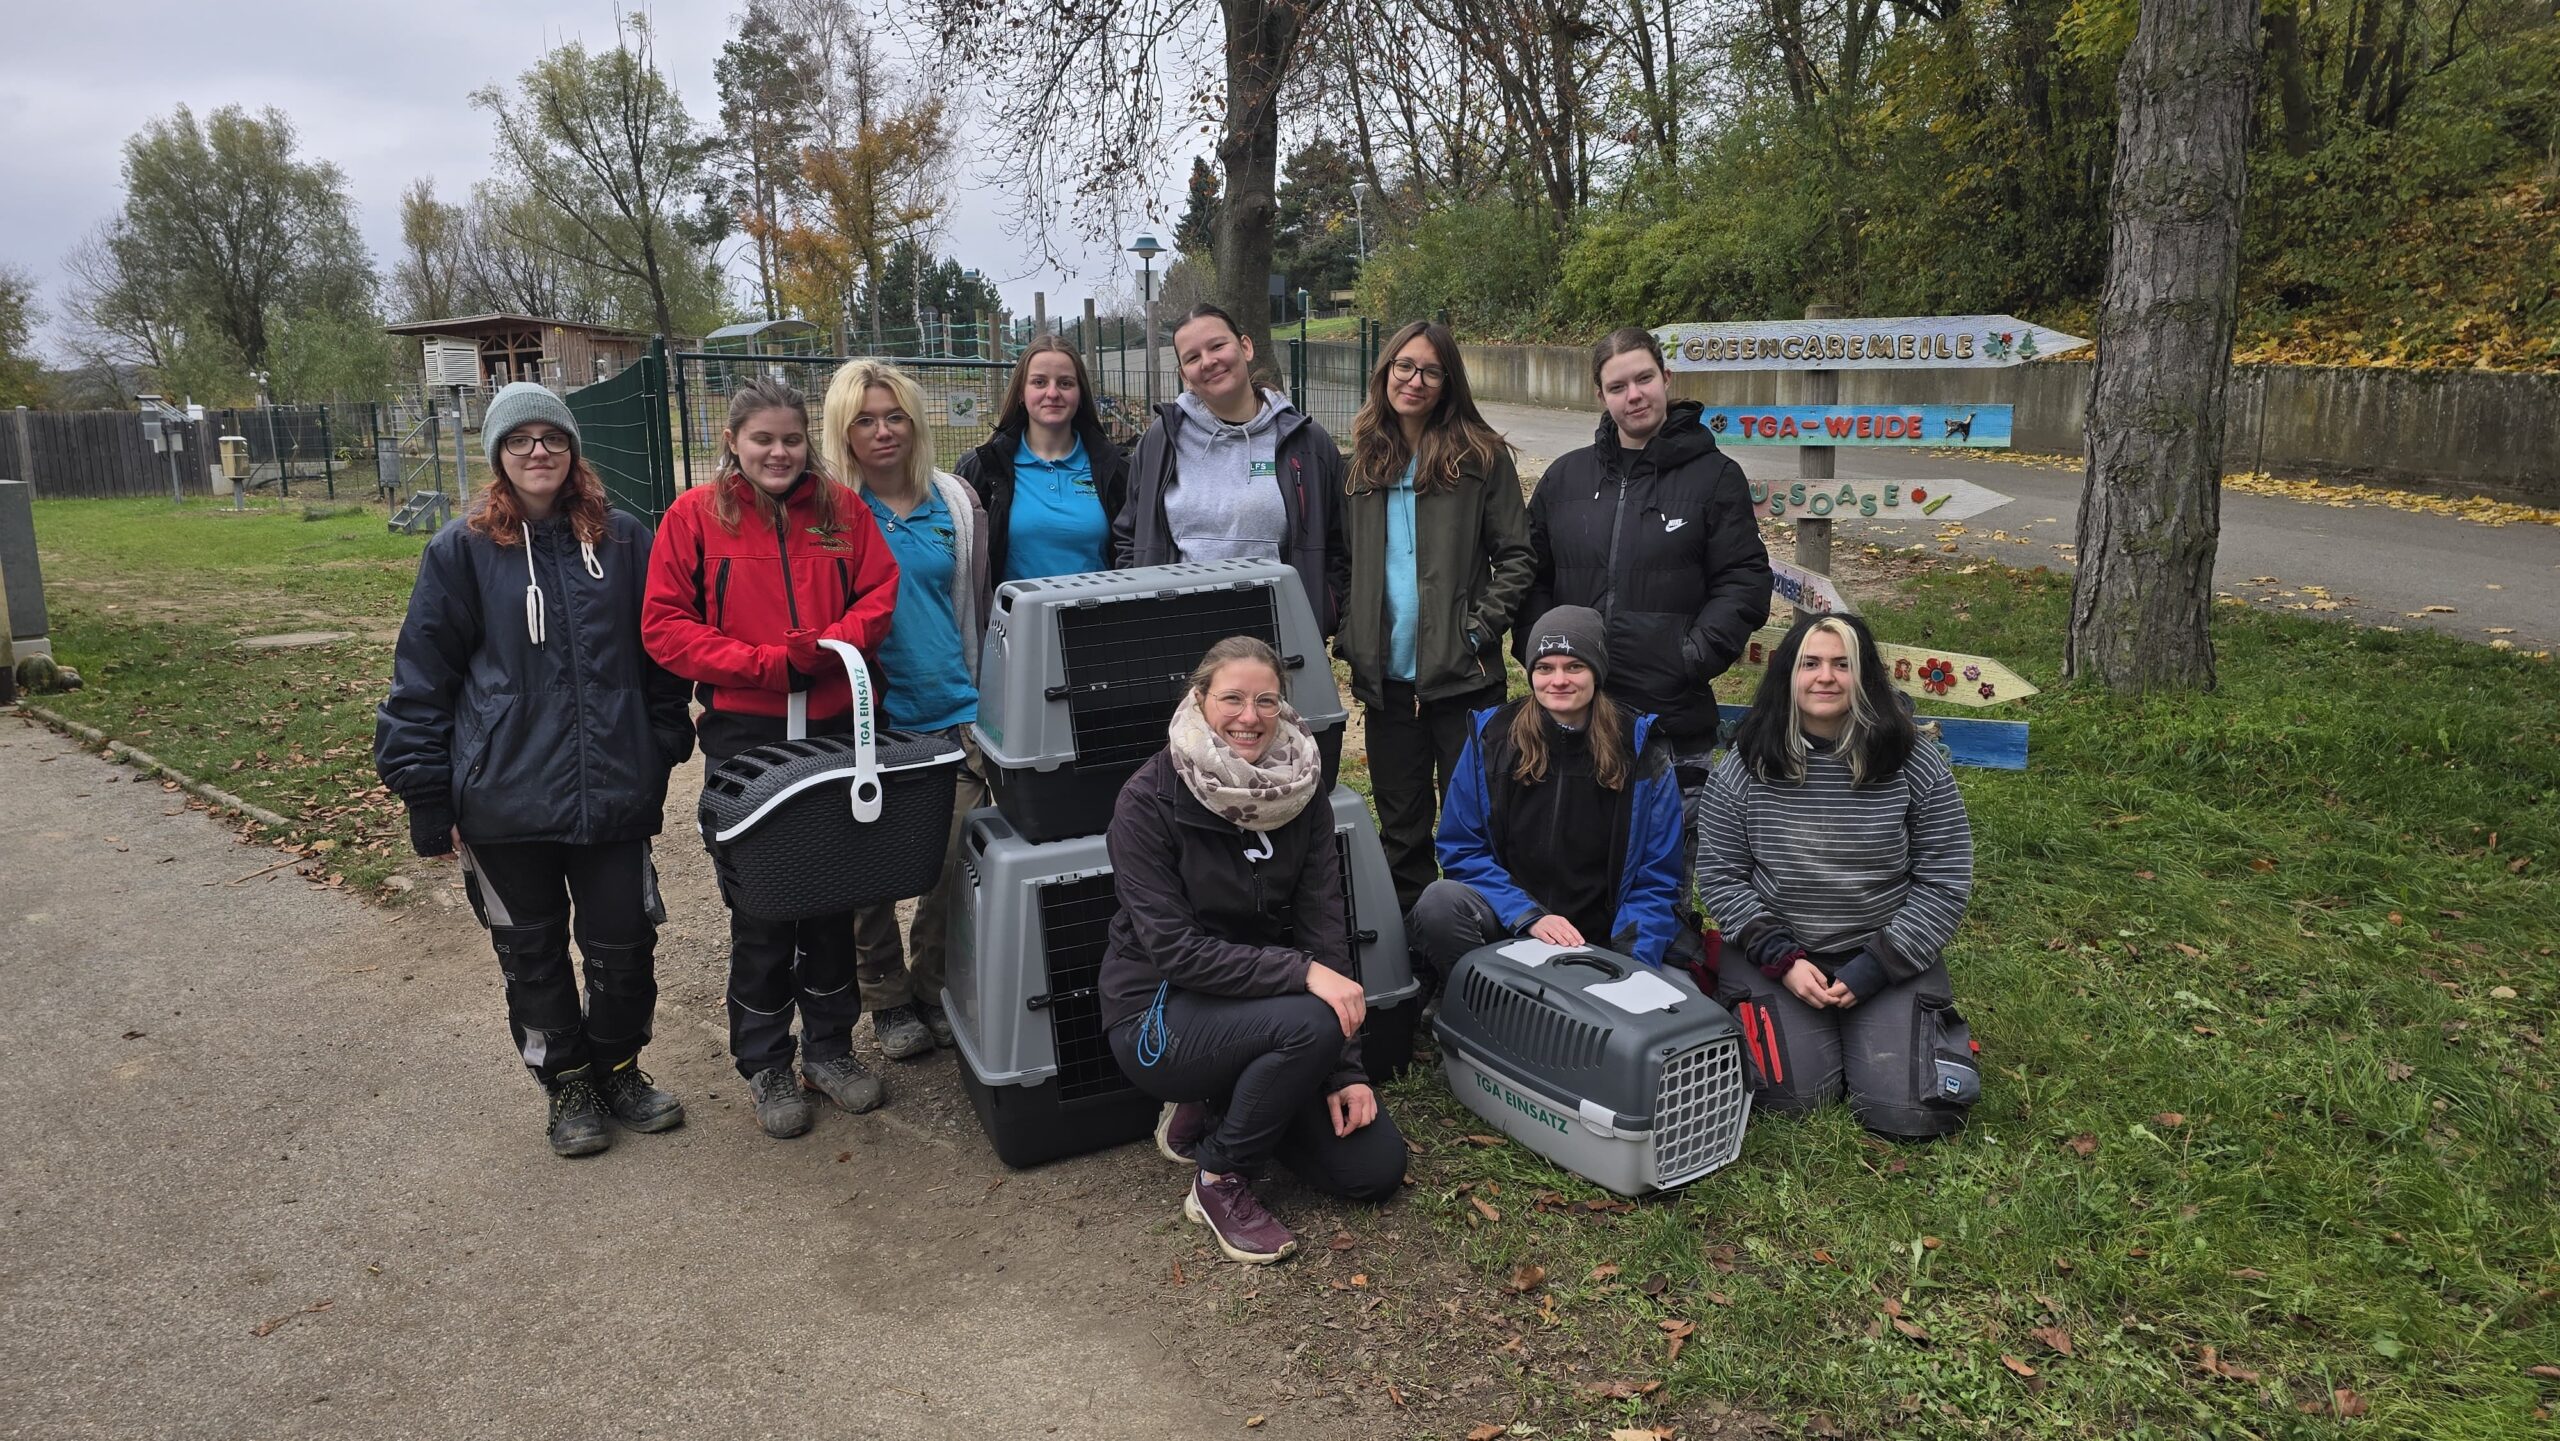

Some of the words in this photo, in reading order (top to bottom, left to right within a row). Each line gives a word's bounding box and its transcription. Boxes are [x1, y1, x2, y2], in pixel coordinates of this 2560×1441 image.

[1683, 333, 1975, 361] GREENCAREMEILE
[1738, 415, 1923, 438] TGA-WEIDE
[1668, 518, 1683, 527] NIKE
[854, 667, 870, 717] EINSATZ
[860, 720, 871, 747] TGA
[1475, 1071, 1502, 1100] TGA
[1505, 1090, 1569, 1135] EINSATZ
